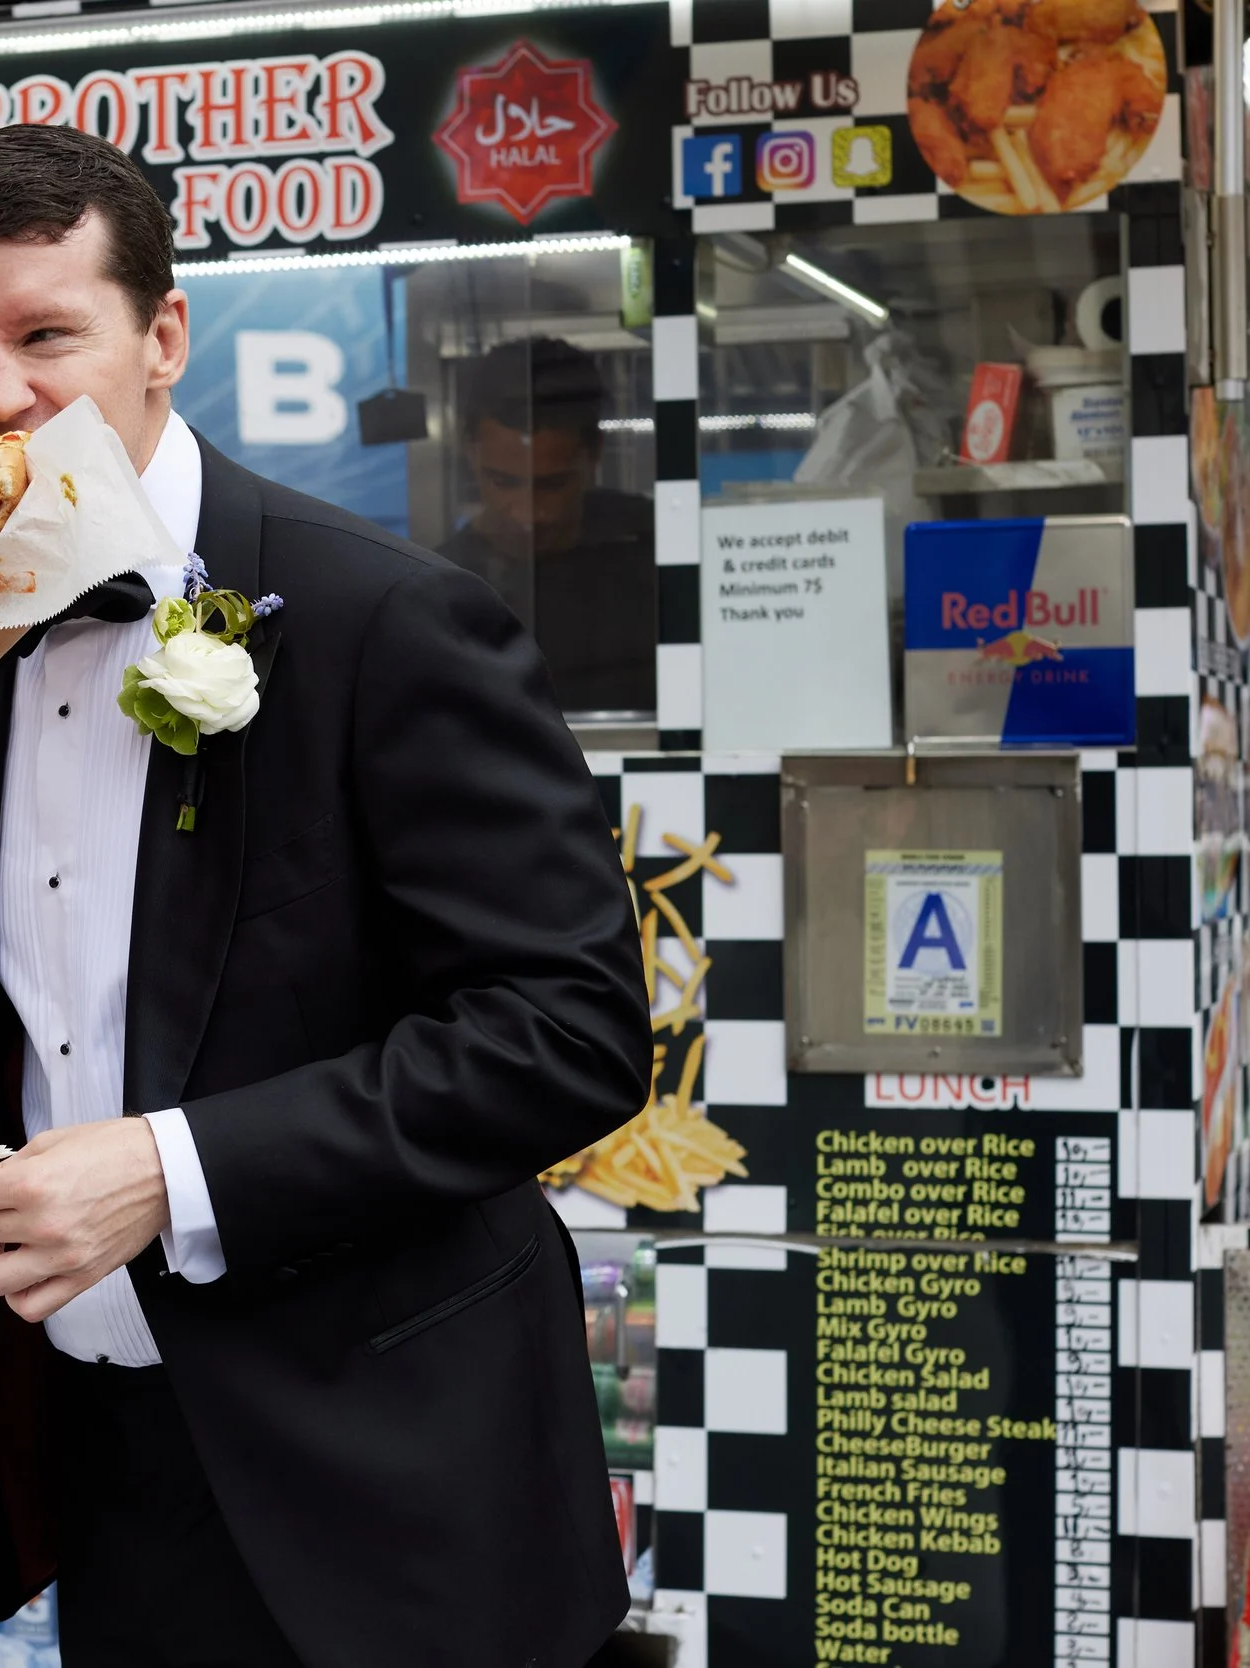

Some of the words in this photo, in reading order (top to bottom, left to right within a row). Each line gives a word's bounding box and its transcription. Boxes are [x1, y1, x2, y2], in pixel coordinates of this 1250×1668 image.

[685, 76, 802, 117] Follow
[809, 71, 859, 109] Us
[475, 92, 575, 147] حلال
[490, 144, 562, 168] HALAL
[171, 157, 385, 248] FOOD
[235, 330, 348, 446] B
[717, 536, 744, 549] We
[750, 532, 803, 549] accept
[806, 528, 849, 545] debit
[723, 558, 736, 573] &
[741, 555, 788, 572] credit
[792, 552, 836, 569] cards
[719, 580, 799, 597] Minimum
[720, 604, 770, 622] Thank
[773, 606, 805, 623] you
[941, 588, 1018, 631] Red
[1025, 588, 1099, 627] Bull
[947, 670, 1024, 685] ENERGY
[1030, 668, 1090, 685] DRINK
[898, 892, 967, 970] A
[875, 1071, 1031, 1104] LUNCH
[816, 1130, 915, 1155] Chicken
[919, 1137, 978, 1156] over
[982, 1133, 1035, 1157] Rice
[816, 1154, 887, 1177] Lamb
[902, 1160, 960, 1179] over
[964, 1156, 1018, 1180] Rice
[816, 1177, 906, 1200] Combo
[909, 1183, 967, 1202] over
[972, 1180, 1025, 1204] Rice
[816, 1200, 899, 1224] Falafel
[904, 1206, 962, 1226] over
[966, 1203, 1020, 1228] Rice
[816, 1247, 907, 1275] Shrimp
[911, 1253, 968, 1273] over
[973, 1251, 1027, 1274] Rice
[816, 1268, 915, 1294] Chicken
[920, 1272, 981, 1300] Gyro
[816, 1292, 887, 1317] Lamb
[896, 1295, 958, 1323] Gyro
[816, 1315, 863, 1339] Mix
[867, 1318, 928, 1344] Gyro
[816, 1338, 900, 1363] Falafel
[905, 1342, 966, 1367] Gyro
[816, 1361, 915, 1387] Chicken
[921, 1365, 990, 1390] Salad
[816, 1385, 887, 1409] Lamb
[891, 1388, 958, 1412] salad
[816, 1407, 887, 1437] Philly
[890, 1411, 982, 1437] Cheese
[986, 1415, 1057, 1440] Steak
[816, 1454, 896, 1480] Italian
[901, 1458, 1006, 1489] Sausage
[816, 1477, 902, 1502] French
[906, 1481, 967, 1506] Fries
[816, 1500, 915, 1526] Chicken
[919, 1505, 998, 1536] Wings
[816, 1523, 915, 1550] Chicken
[920, 1529, 1001, 1555] Kebab
[816, 1546, 862, 1570] Hot
[867, 1548, 919, 1579] Dog
[816, 1569, 862, 1593] Hot
[866, 1572, 971, 1604] Sausage
[815, 1592, 878, 1617] Soda
[882, 1596, 931, 1620] Can
[815, 1615, 878, 1640] Soda
[882, 1618, 959, 1646] bottle
[814, 1638, 891, 1664] Water
